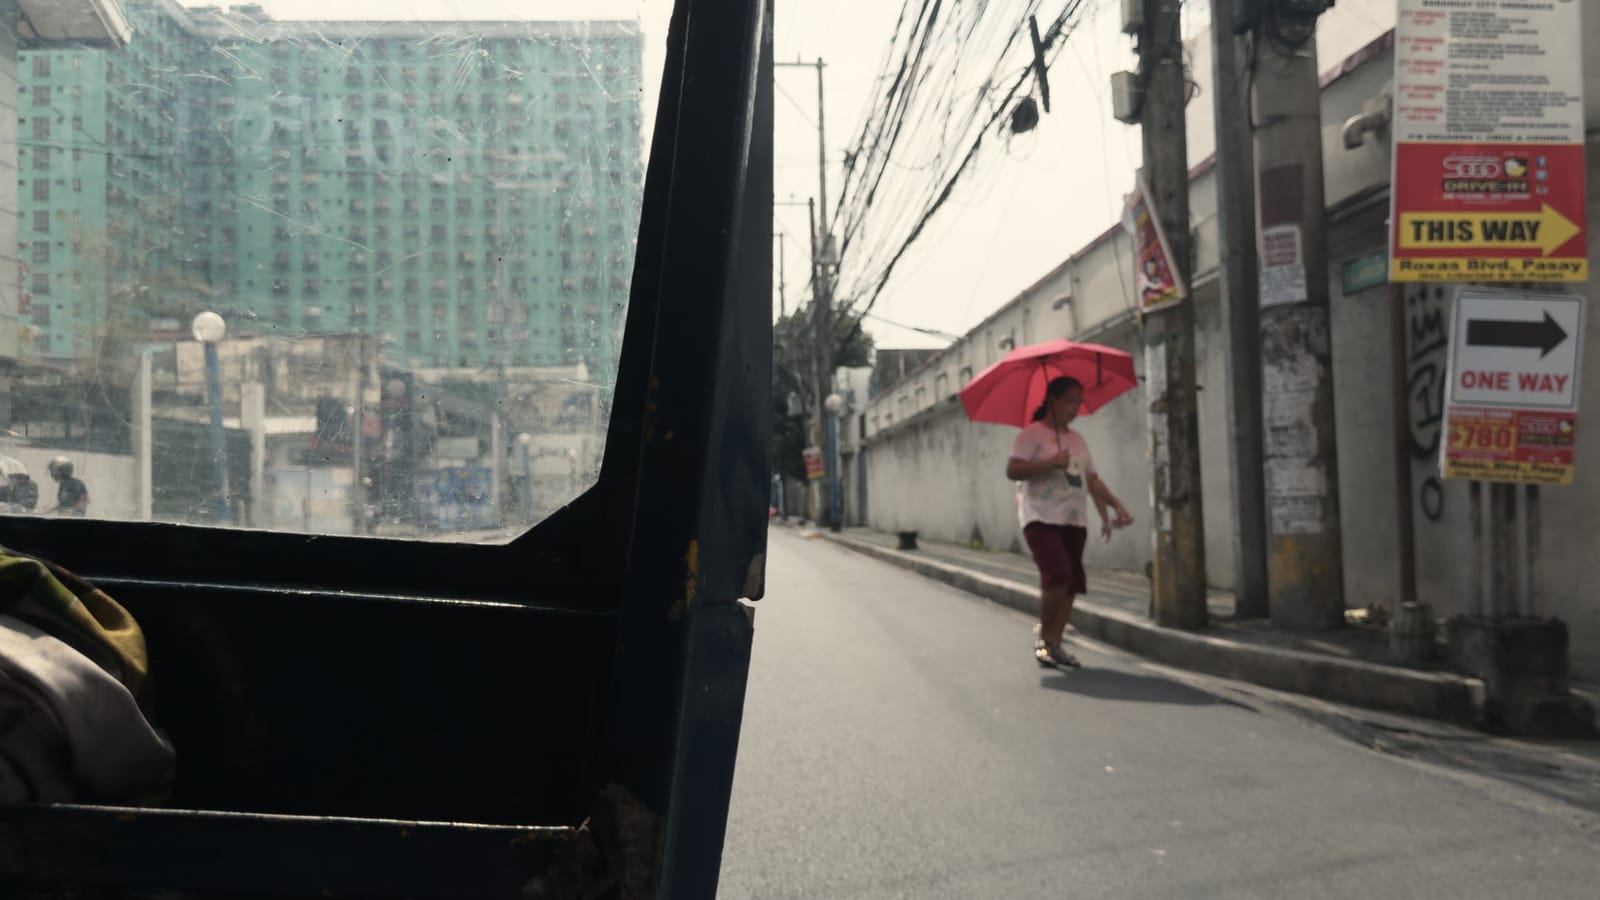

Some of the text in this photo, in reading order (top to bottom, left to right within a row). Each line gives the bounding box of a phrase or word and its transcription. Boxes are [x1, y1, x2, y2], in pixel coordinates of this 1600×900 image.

[1443, 181, 1528, 192] DRIVE-IN
[1410, 220, 1541, 241] THIS WAY
[1400, 258, 1459, 271] Roxas
[1522, 260, 1583, 273] Pasay
[1460, 370, 1569, 393] ONE WAY
